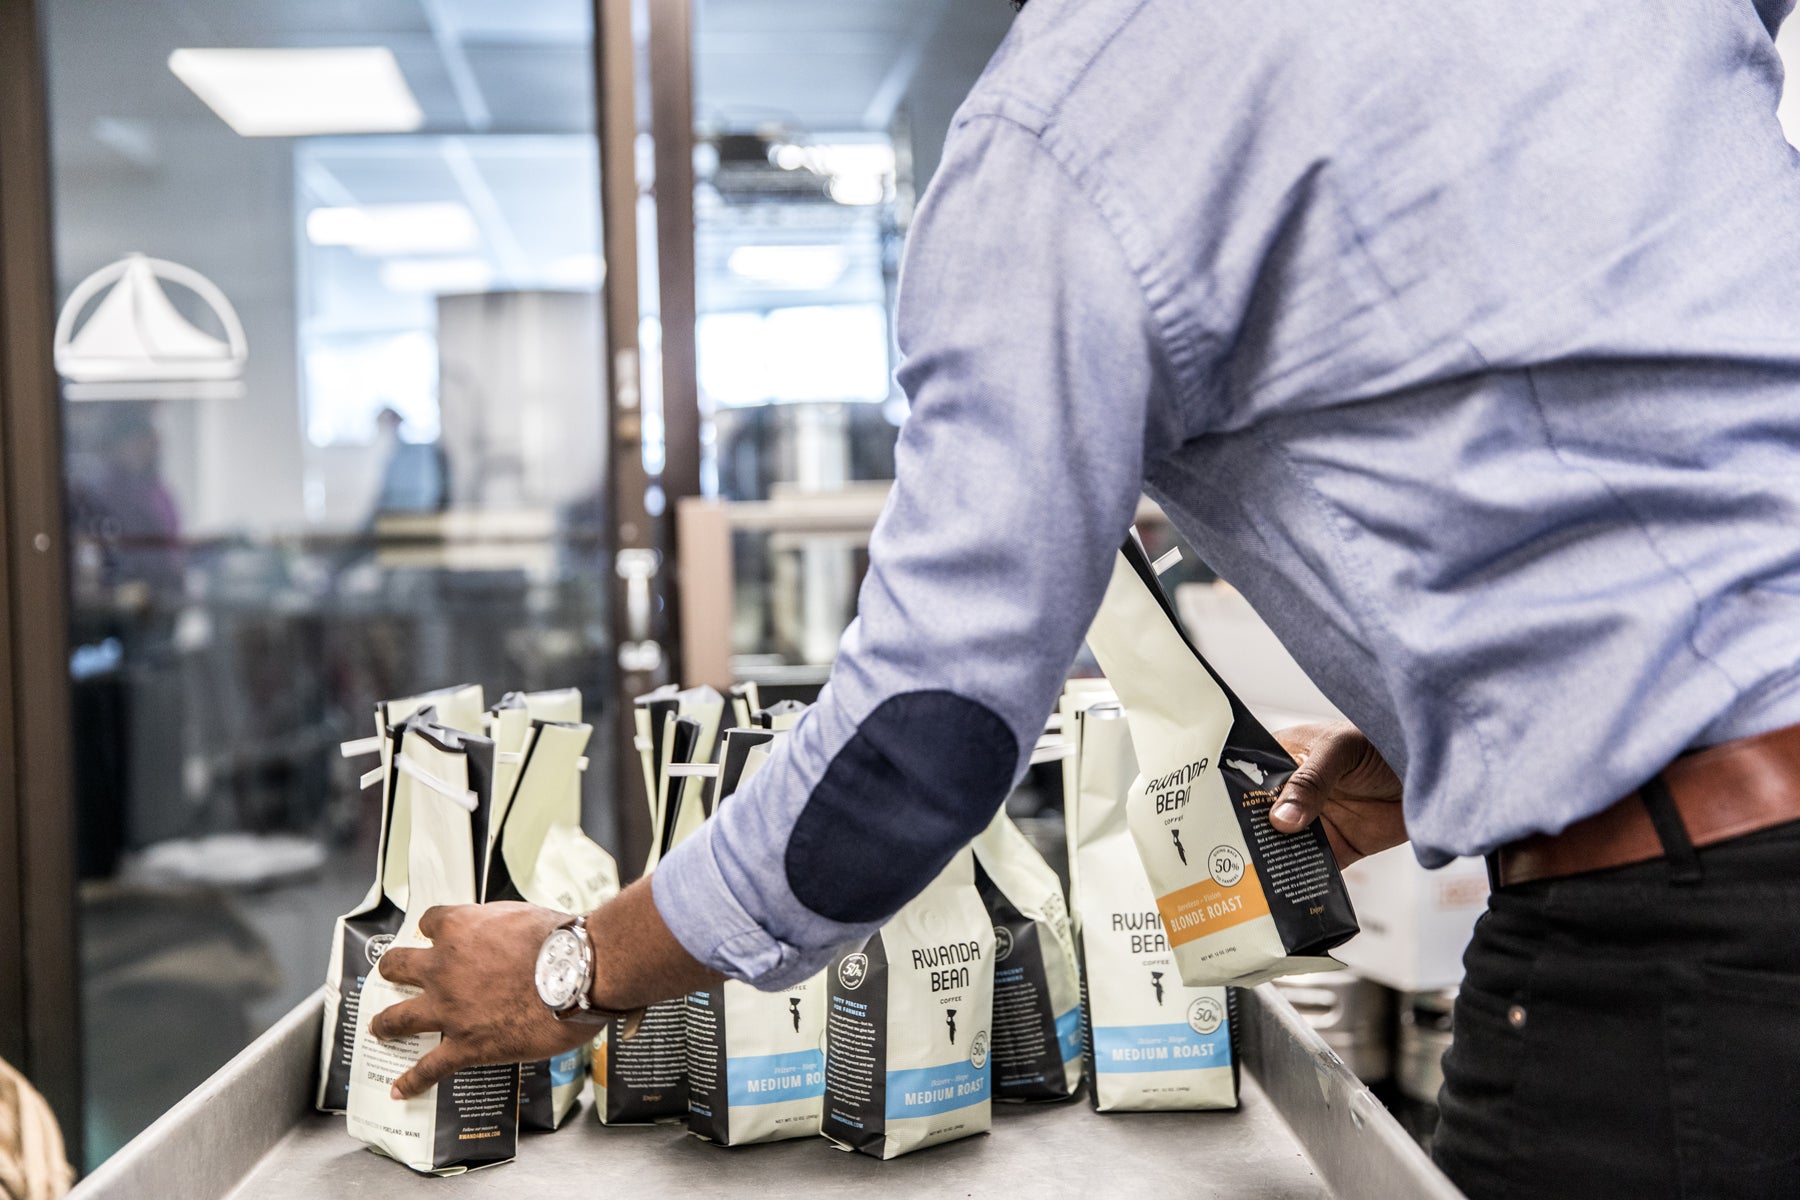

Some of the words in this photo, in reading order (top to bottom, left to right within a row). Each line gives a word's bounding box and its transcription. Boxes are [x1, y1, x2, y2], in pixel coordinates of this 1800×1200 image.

[1145, 758, 1208, 795] RWANDA
[1156, 786, 1191, 815] BEAN
[1215, 858, 1239, 873] 50%
[1170, 910, 1206, 932] BLONDE
[1206, 896, 1244, 919] ROAST
[912, 941, 981, 969] RWANDA
[843, 962, 862, 977] 50%
[931, 967, 969, 992] BEAN
[845, 1000, 868, 1010] PERCENT
[940, 996, 962, 1004] COFFEE
[843, 1007, 866, 1017] FARMERS
[1194, 1008, 1217, 1022] 50%
[1112, 1046, 1168, 1061] MEDIUM
[1173, 1043, 1215, 1058] ROAST
[747, 1075, 802, 1093] MEDIUM
[904, 1087, 954, 1105] MEDIUM
[957, 1077, 984, 1096] ROAST
